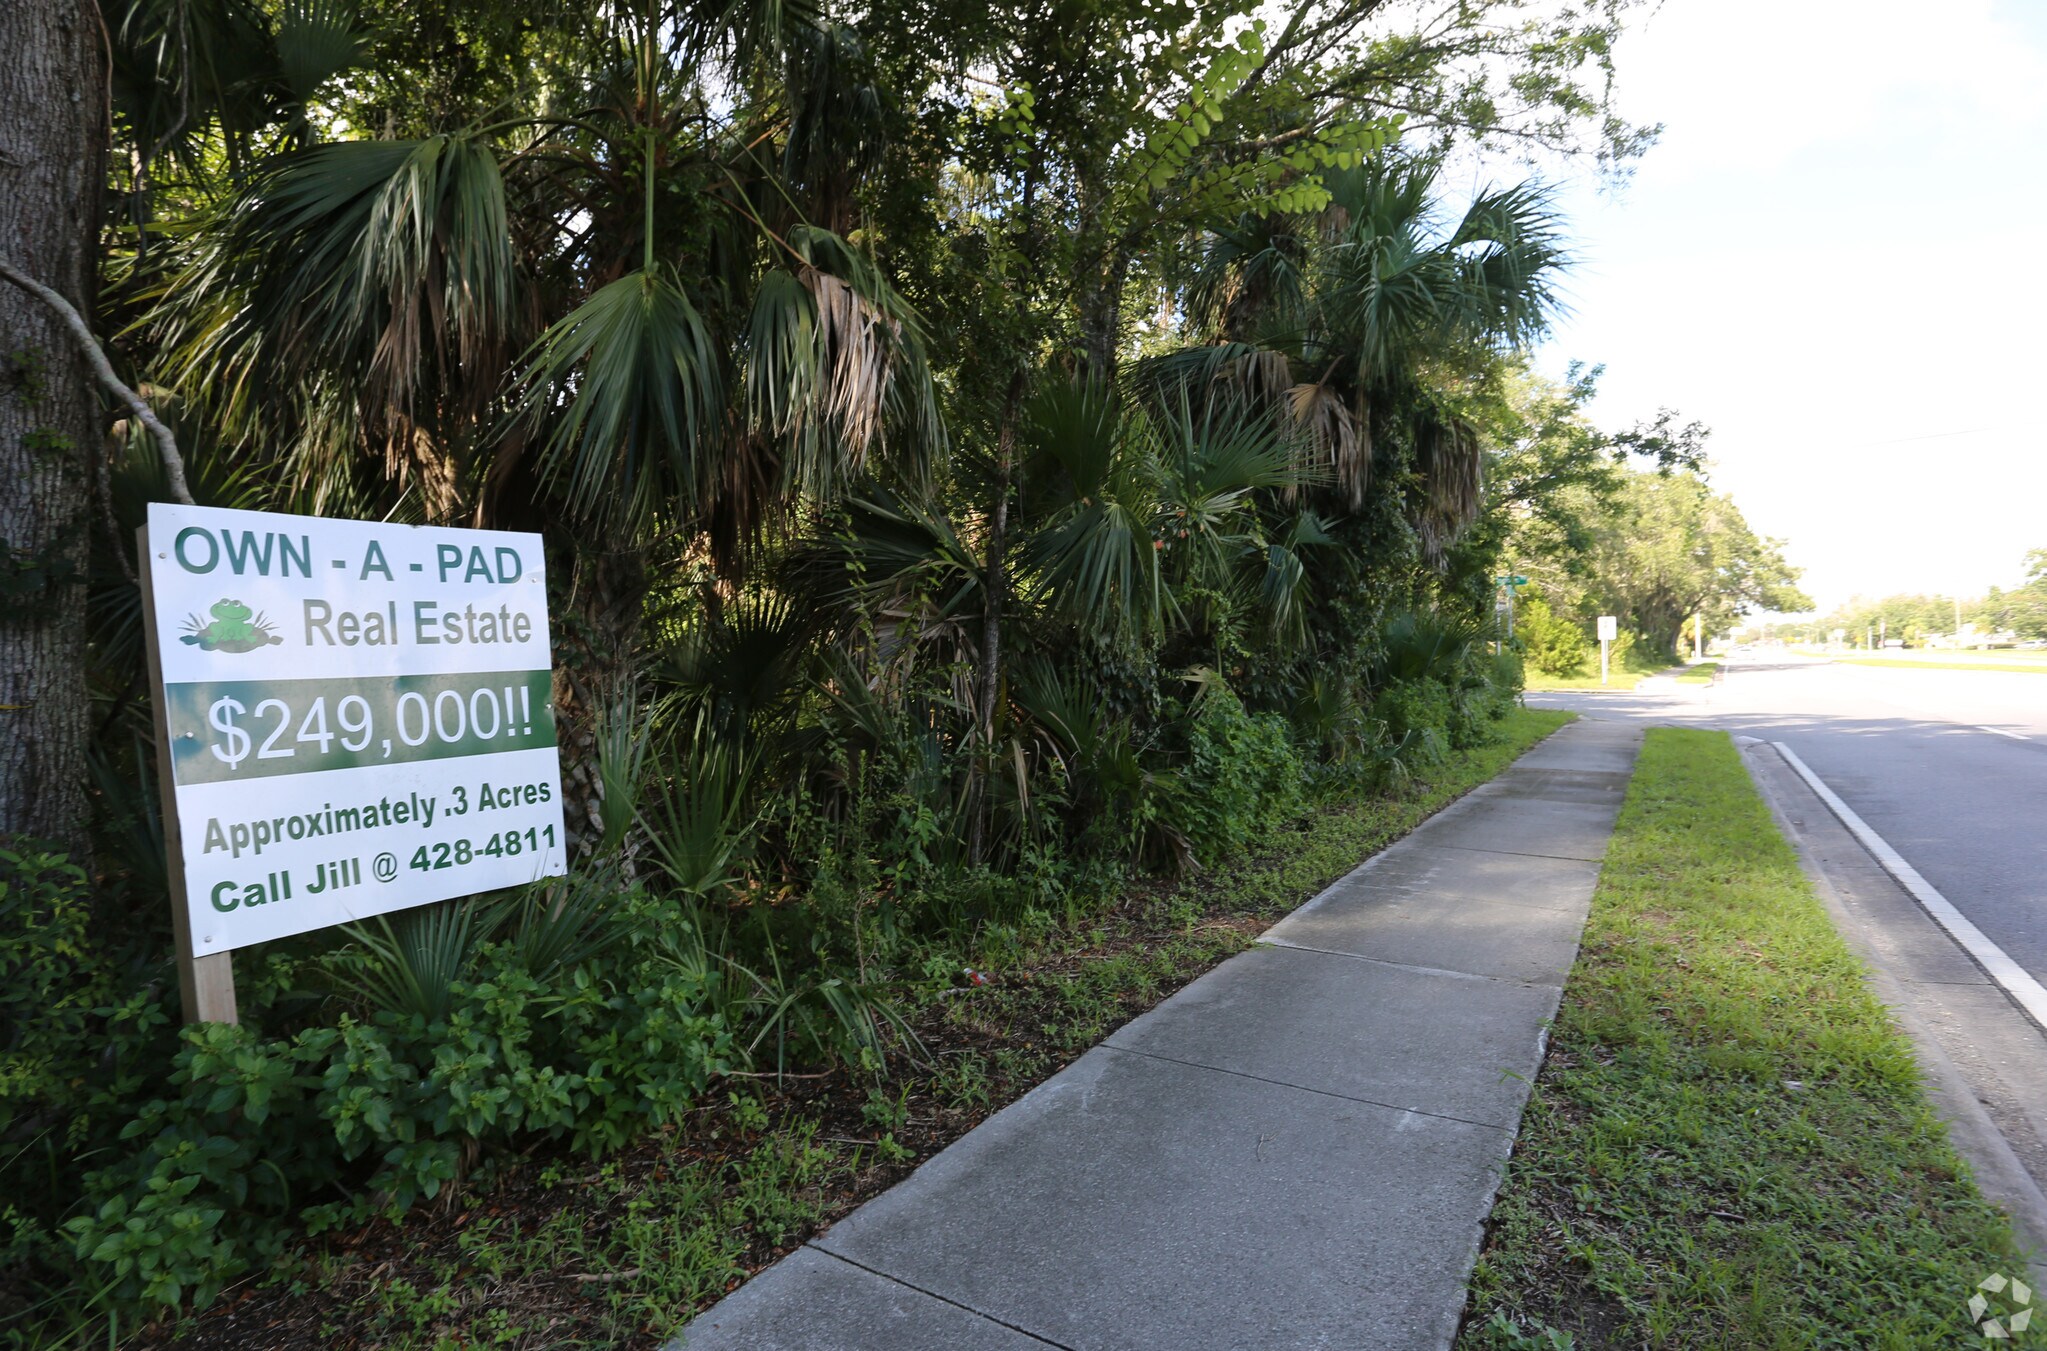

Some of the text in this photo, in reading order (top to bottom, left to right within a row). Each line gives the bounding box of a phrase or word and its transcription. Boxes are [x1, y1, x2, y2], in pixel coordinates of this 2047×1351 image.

[174, 526, 312, 578] OWN
[359, 540, 394, 581] A
[437, 543, 522, 584] PAD
[303, 598, 531, 646] Real Estate
[209, 686, 532, 770] $249,000!!
[203, 781, 551, 858] Approximately .3 Acres
[210, 824, 555, 913] Call Jill @ 428-4811
